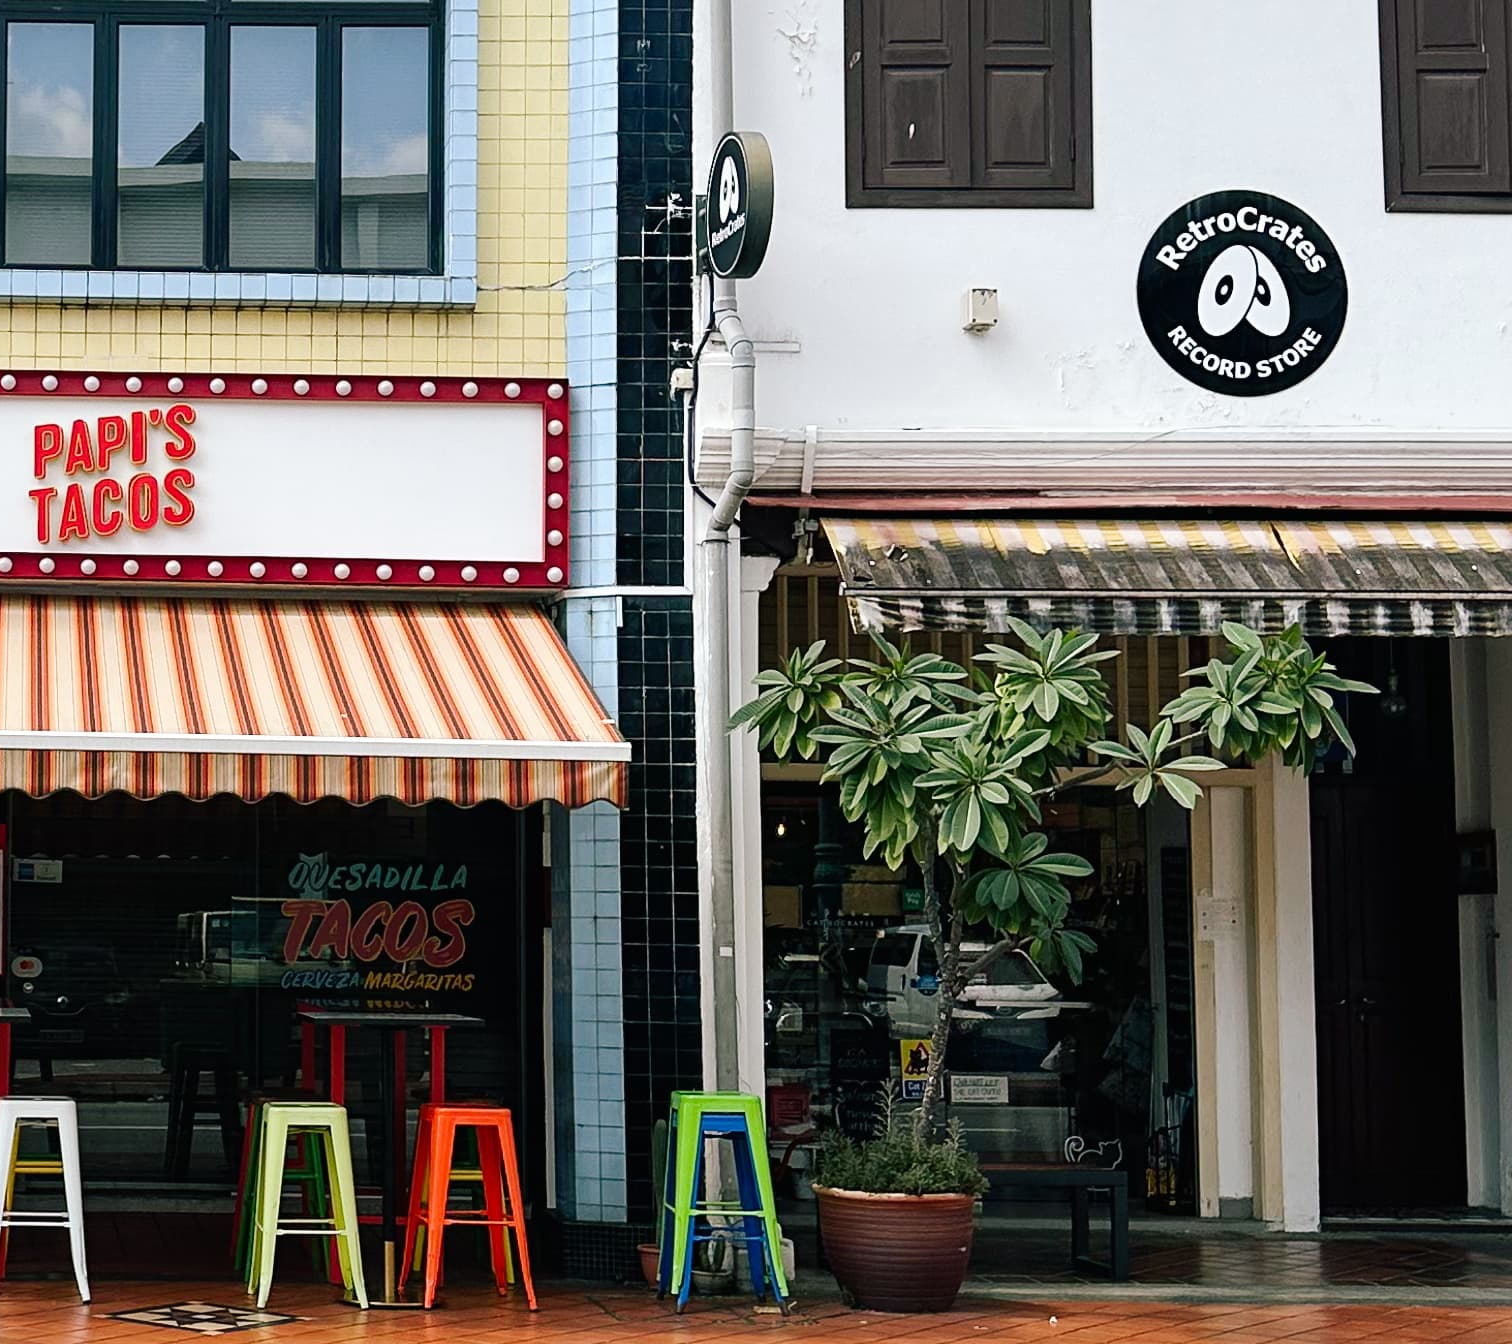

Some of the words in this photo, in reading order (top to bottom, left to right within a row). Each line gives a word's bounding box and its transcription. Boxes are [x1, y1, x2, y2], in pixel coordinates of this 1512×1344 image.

[711, 212, 746, 249] RetroCrates
[1155, 206, 1327, 273] RetroCrates
[1167, 325, 1252, 379] RECORD
[1255, 327, 1323, 378] STORE
[33, 402, 197, 480] PAPI'S
[28, 468, 196, 544] TACOS
[288, 862, 468, 891] QUESADILLA
[281, 898, 475, 968] TACOS
[281, 971, 360, 989] CERVEZA
[364, 971, 475, 991] MARGARITAS
